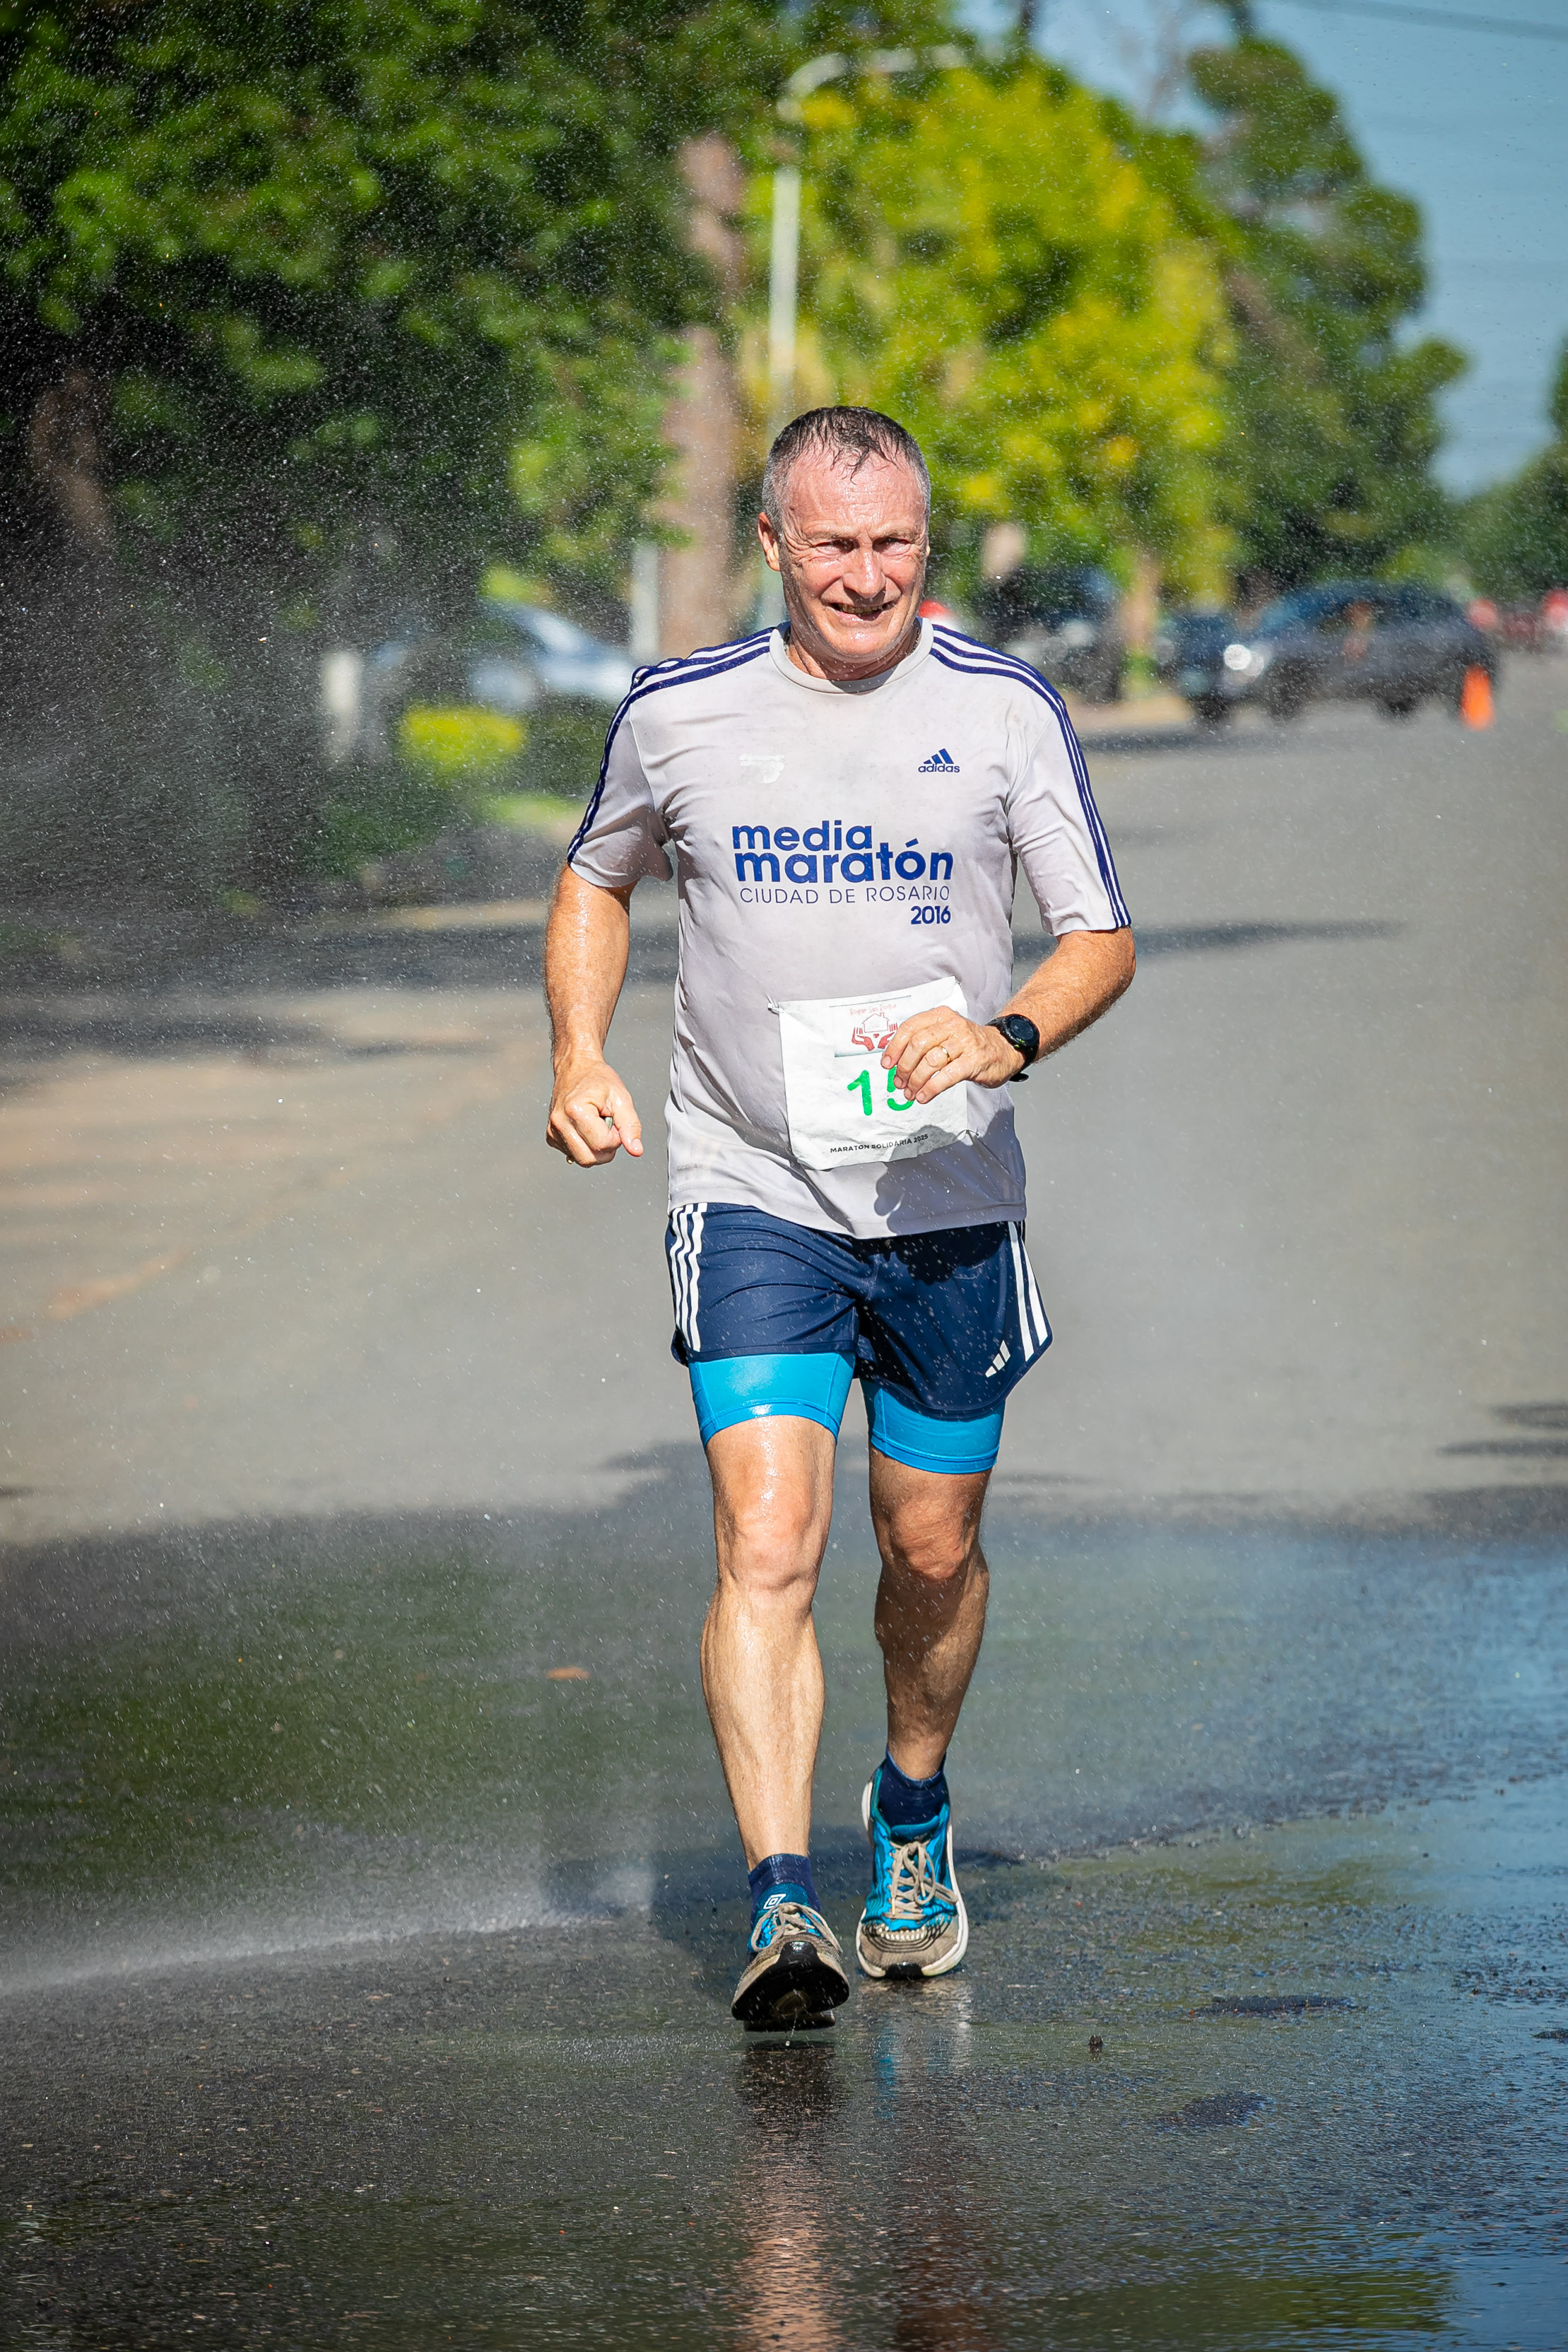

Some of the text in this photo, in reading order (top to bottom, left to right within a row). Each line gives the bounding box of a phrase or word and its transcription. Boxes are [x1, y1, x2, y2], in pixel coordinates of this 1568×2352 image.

[918, 763, 960, 773] adidas
[732, 820, 873, 851] media
[734, 838, 954, 883] maratón
[740, 886, 950, 904] CIUDAD DE ROSARIO
[911, 905, 951, 924] 2016
[871, 1139, 912, 1149] SOLIDARIA
[914, 1134, 929, 1143] 2025
